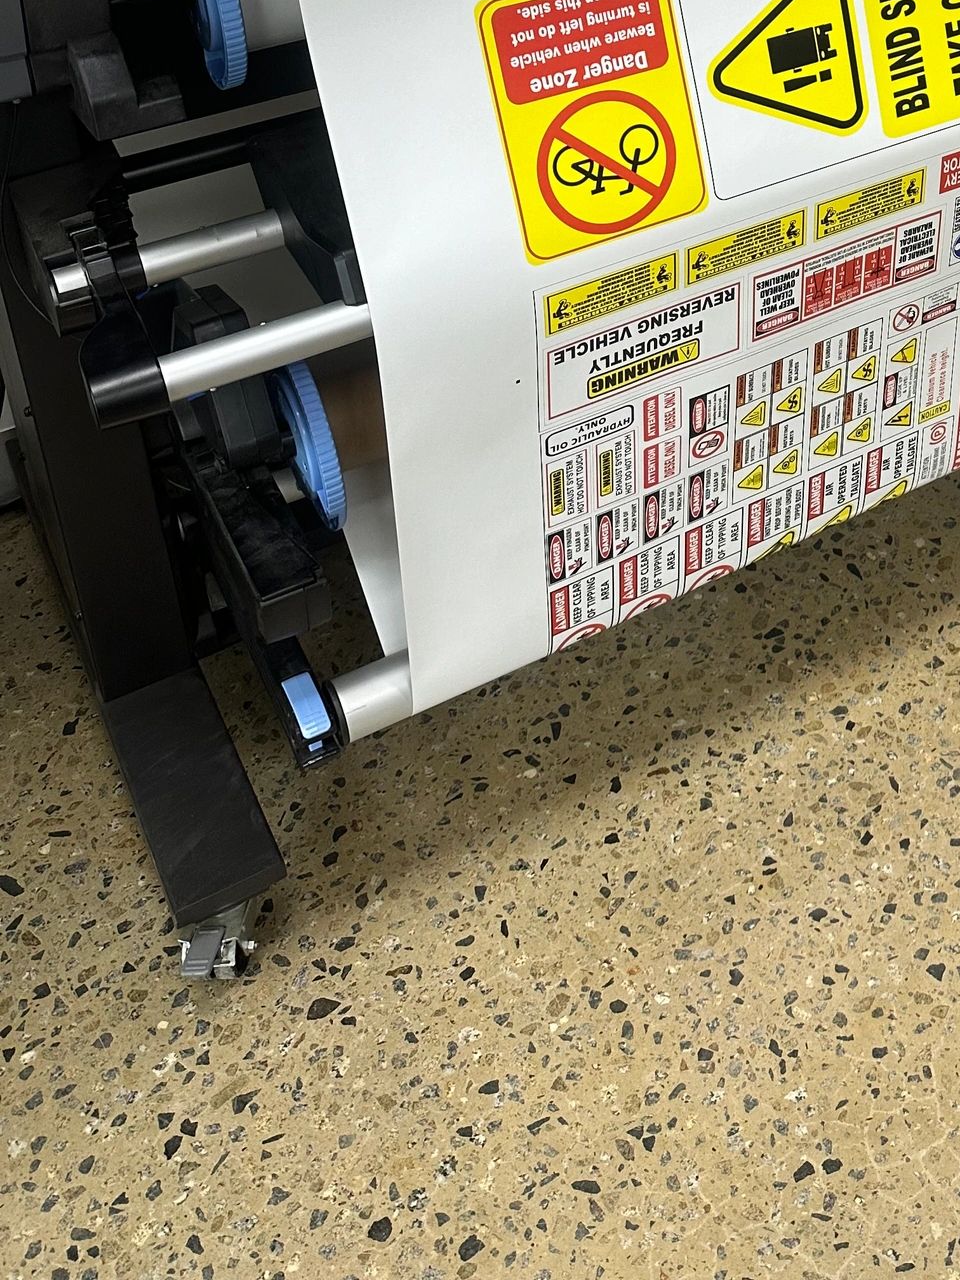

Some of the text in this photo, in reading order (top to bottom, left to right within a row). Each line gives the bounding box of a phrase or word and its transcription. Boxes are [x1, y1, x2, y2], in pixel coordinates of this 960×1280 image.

[511, 2, 650, 47] is turning left do not
[517, 3, 551, 20] side.
[510, 23, 656, 69] Beware when vehicle
[530, 50, 648, 92] Danger Zone
[886, 27, 930, 118] BLIND
[900, 229, 936, 247] ELECTRICAL
[904, 222, 933, 237] HAZARDS
[898, 246, 933, 264] BEWARE OF
[900, 238, 933, 254] OVERHEAD
[756, 269, 799, 291] POWERLINES
[900, 261, 930, 276] DANGER
[760, 281, 795, 298] OVERHEAD
[763, 289, 792, 306] CLEAR OF
[638, 288, 735, 333] REVERSING
[760, 297, 795, 316] KEEP WELL
[762, 313, 793, 330] DANGER
[554, 327, 631, 365] VEHICLE
[589, 321, 702, 374] FREQUENTLY
[591, 349, 679, 393] WARNING
[551, 417, 630, 452] HYDRAULIC OIL
[552, 471, 562, 506] WARNING
[587, 577, 596, 618] OF TIPPING
[601, 580, 609, 600] AREA
[553, 590, 565, 623] DANGER
